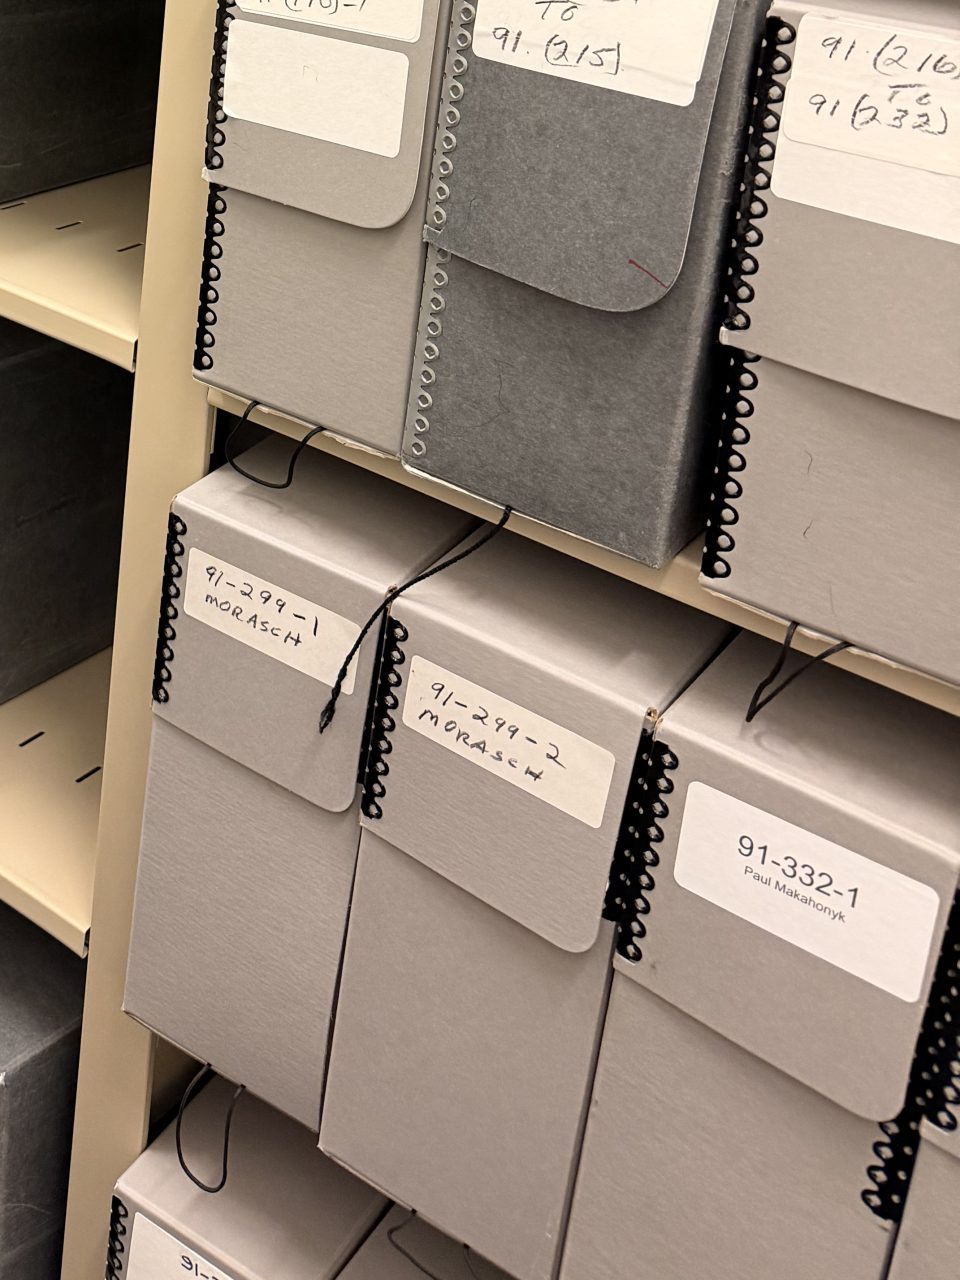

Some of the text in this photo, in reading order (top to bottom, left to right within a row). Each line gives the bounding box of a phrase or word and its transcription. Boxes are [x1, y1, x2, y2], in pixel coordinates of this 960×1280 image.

[534, 0, 578, 22] TO
[204, 594, 302, 648] MORASCH
[205, 565, 320, 638] 91-299-1
[419, 708, 544, 781] MORASCH
[431, 682, 565, 769] 91-299-2
[738, 835, 859, 909] 91-332-1
[744, 865, 846, 923] Paul Makahonyk
